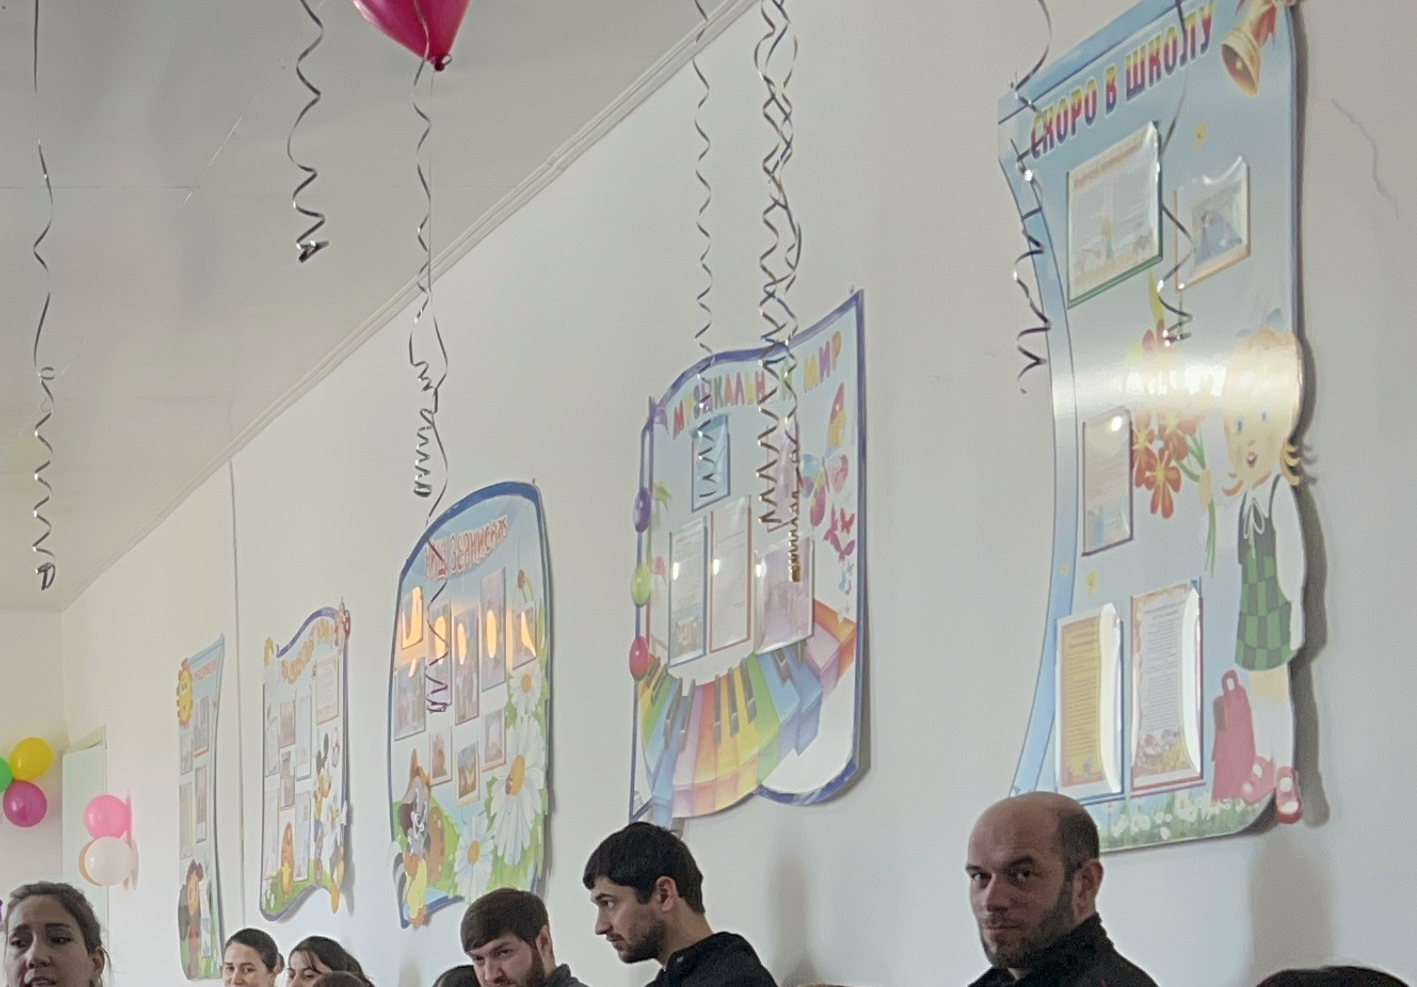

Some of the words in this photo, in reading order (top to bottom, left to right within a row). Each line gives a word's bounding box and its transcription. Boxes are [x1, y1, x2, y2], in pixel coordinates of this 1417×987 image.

[1029, 78, 1097, 160] СКОРО
[1104, 65, 1118, 115] В
[672, 359, 794, 440] МУЗЫКАЛЬНЙ
